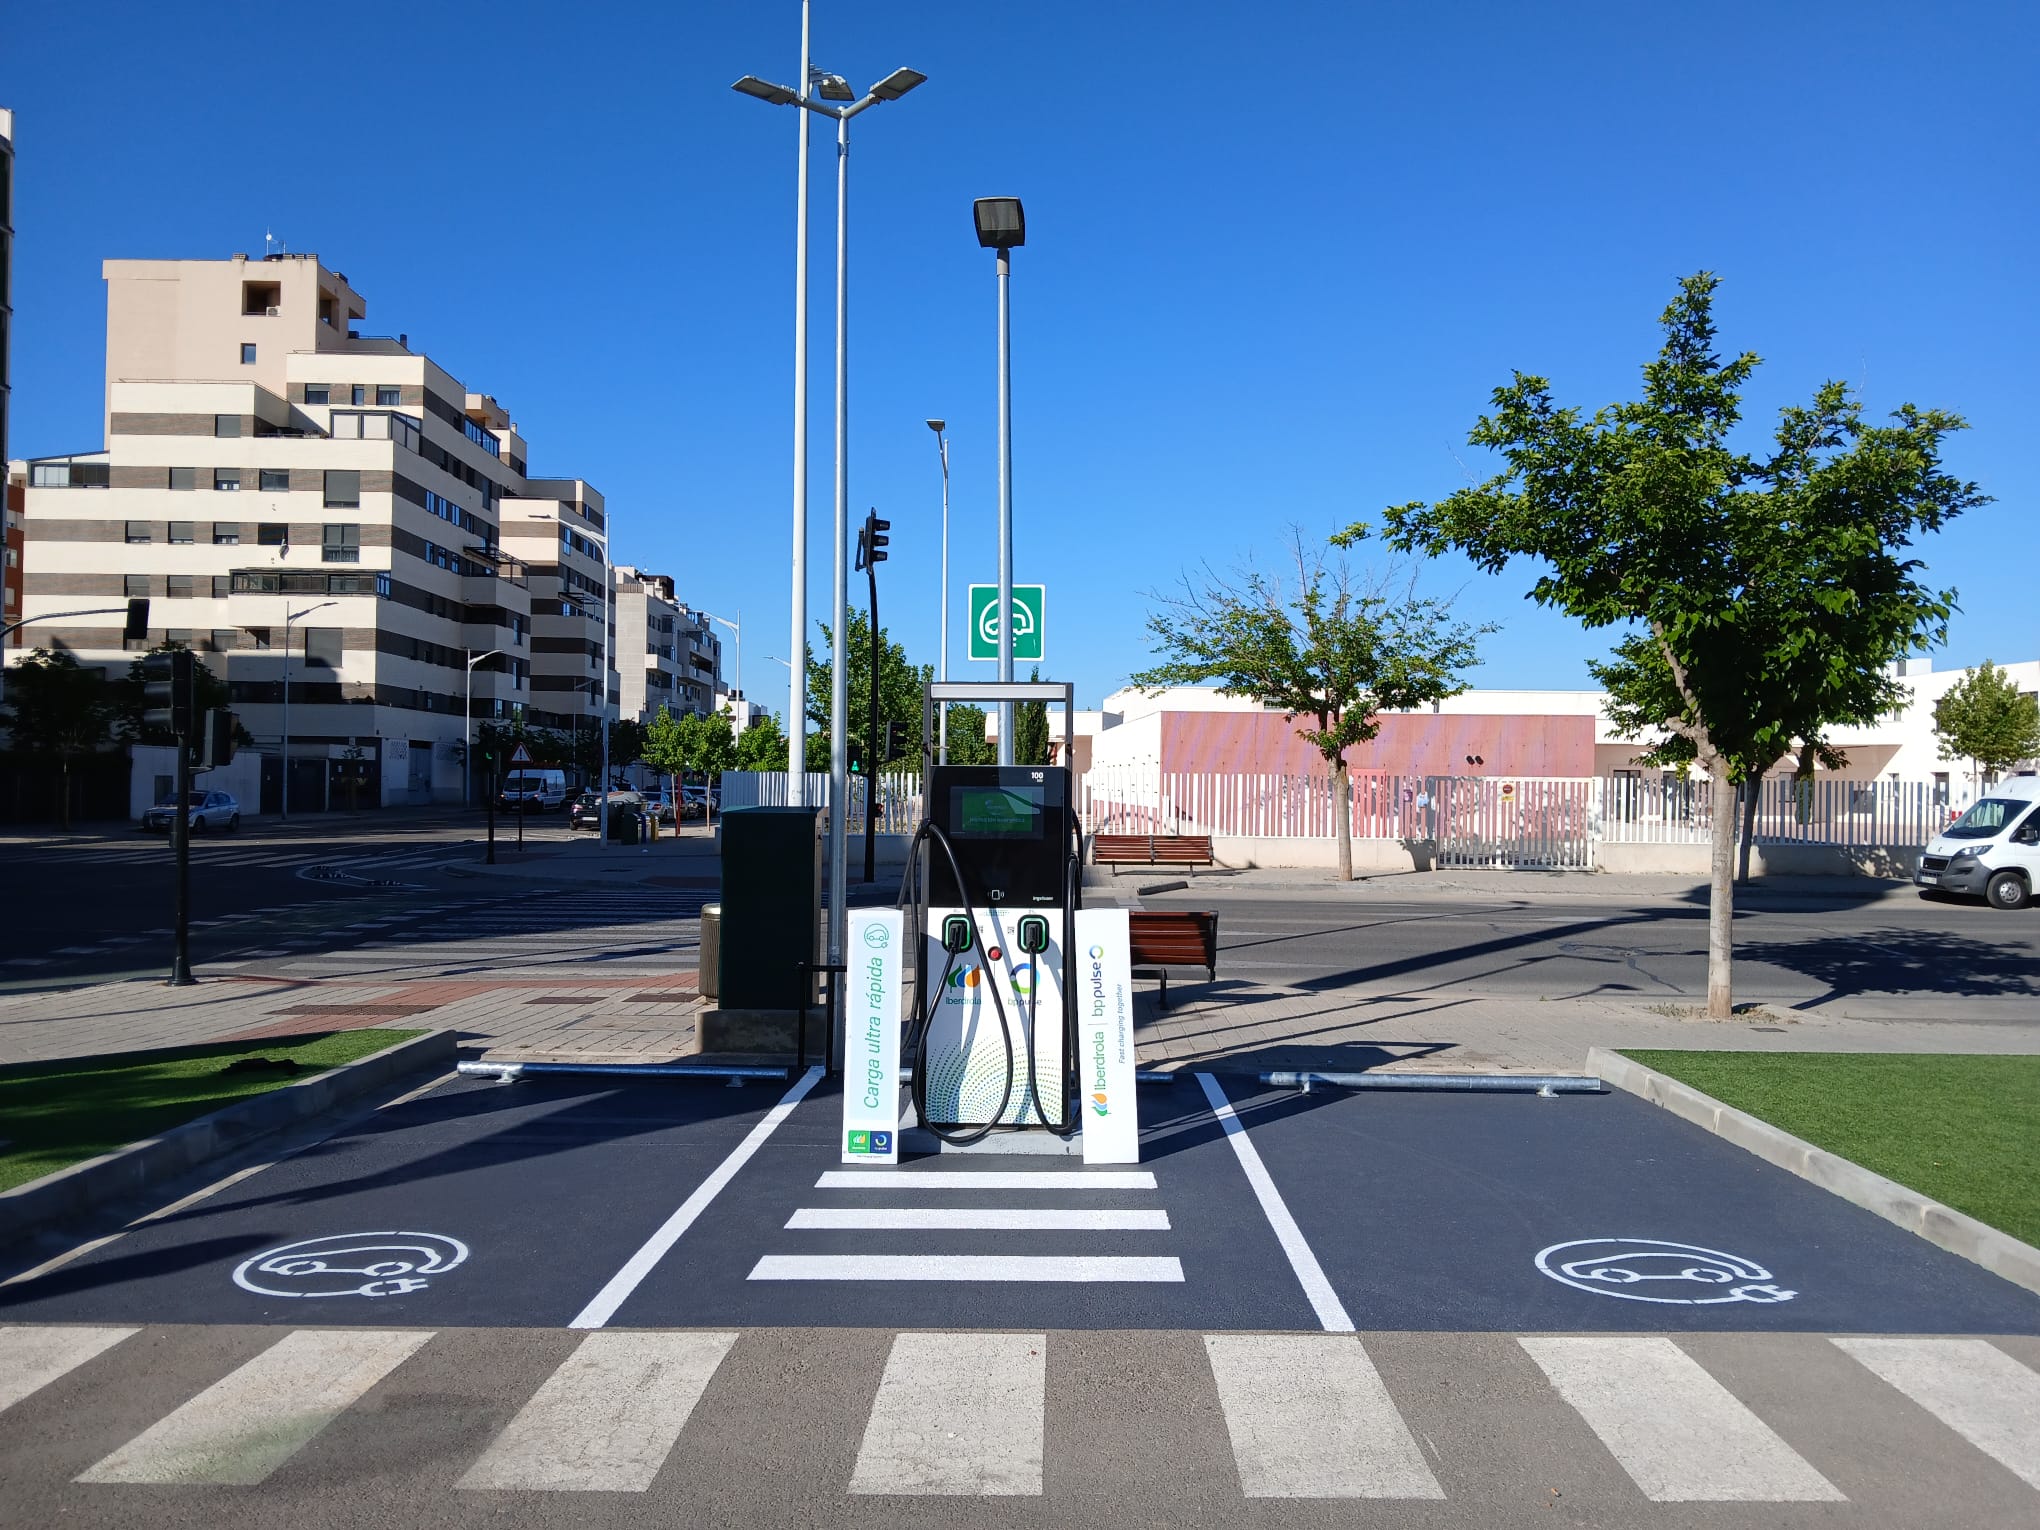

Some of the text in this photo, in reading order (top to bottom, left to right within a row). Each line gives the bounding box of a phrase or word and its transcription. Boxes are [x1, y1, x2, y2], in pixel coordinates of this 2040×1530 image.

[1031, 771, 1044, 779] 100
[945, 997, 982, 1005] Iberdrola
[1115, 984, 1125, 1014] together
[864, 957, 886, 1108] Carga ultra rápida
[1117, 1015, 1126, 1047] charging
[1092, 1031, 1106, 1090] Iberdrola
